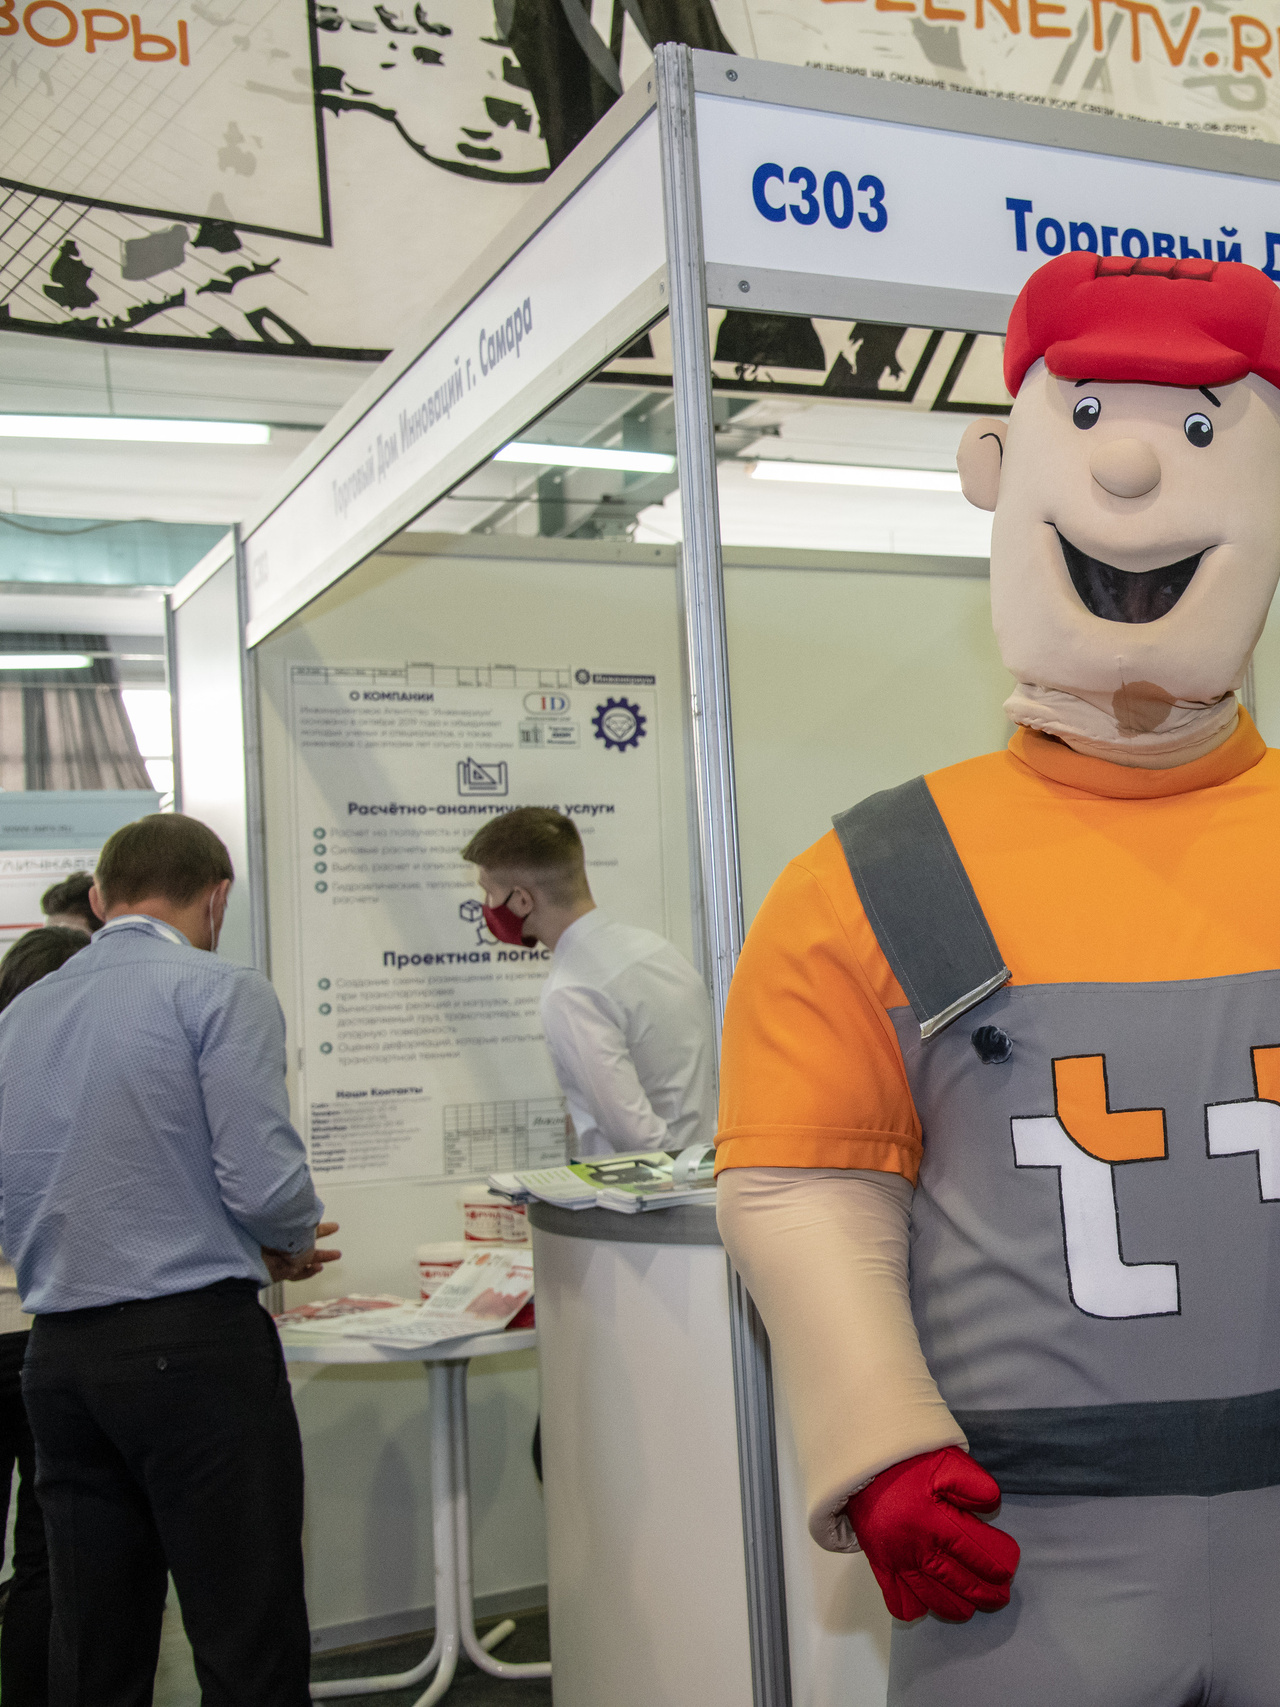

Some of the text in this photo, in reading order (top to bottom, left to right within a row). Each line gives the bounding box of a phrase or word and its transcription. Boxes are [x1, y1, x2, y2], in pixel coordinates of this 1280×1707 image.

[751, 162, 888, 233] С303
[399, 356, 463, 454] Инноваций
[479, 296, 533, 377] Самара
[349, 690, 434, 702] О КОМПАНИИ
[565, 802, 614, 819] услуги
[383, 951, 490, 969] Проектная
